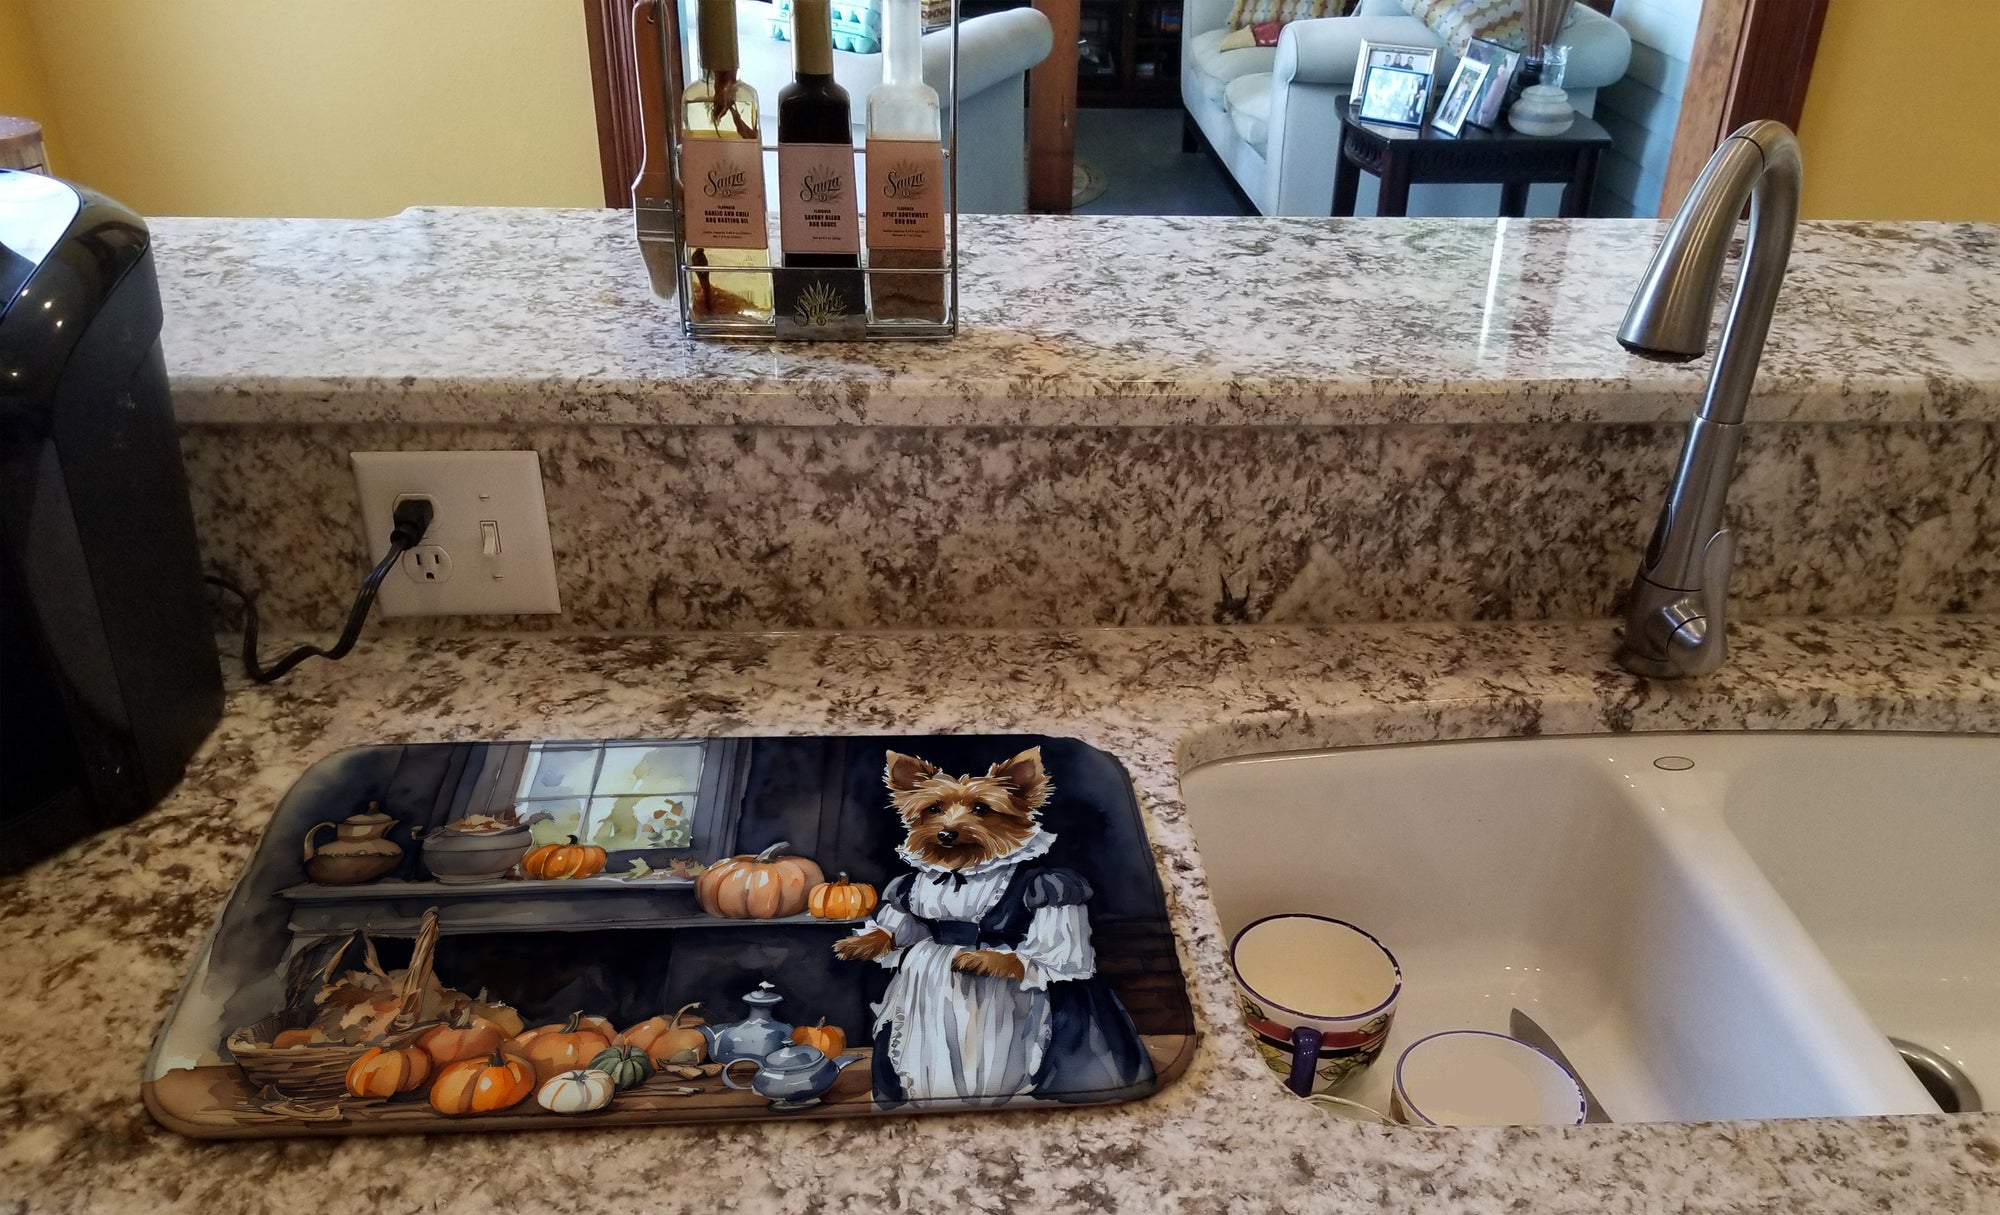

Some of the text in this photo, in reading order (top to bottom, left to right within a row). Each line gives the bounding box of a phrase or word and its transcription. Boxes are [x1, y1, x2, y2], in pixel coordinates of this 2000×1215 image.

[704, 170, 745, 197] Sauza
[800, 175, 841, 202] Sauza
[883, 171, 923, 198] Sauza
